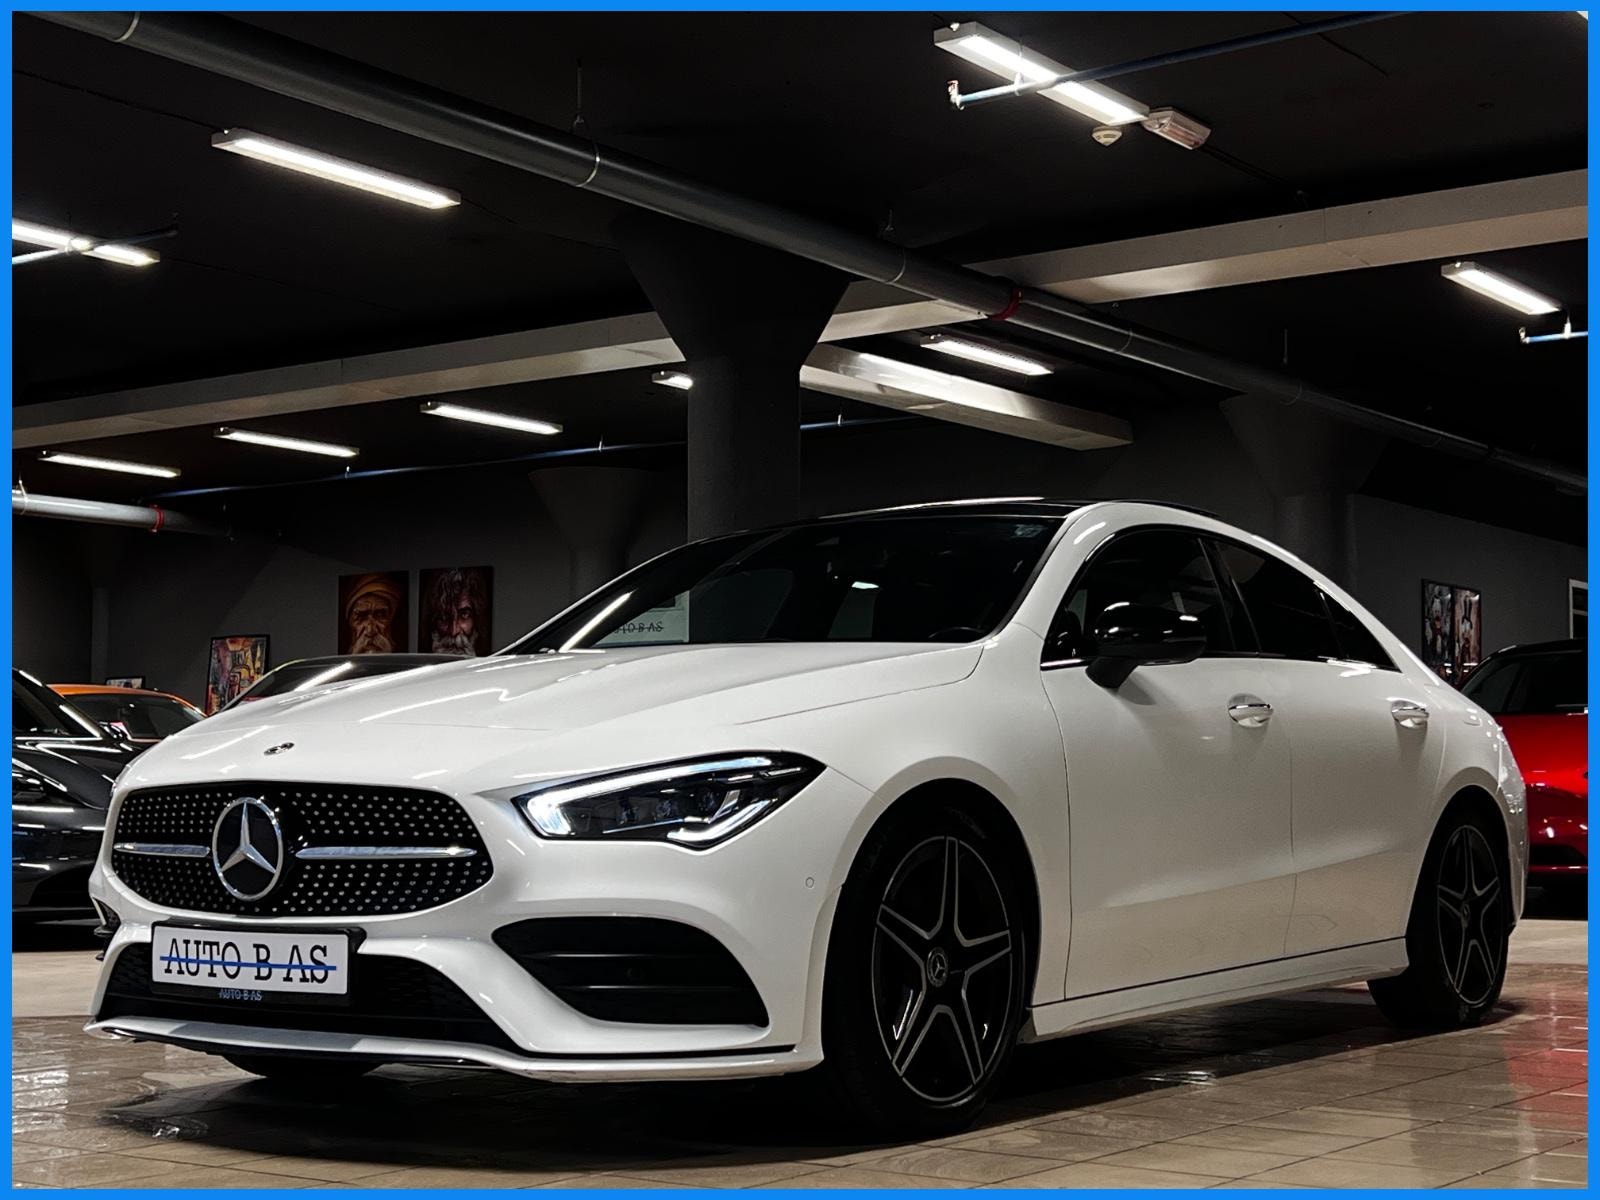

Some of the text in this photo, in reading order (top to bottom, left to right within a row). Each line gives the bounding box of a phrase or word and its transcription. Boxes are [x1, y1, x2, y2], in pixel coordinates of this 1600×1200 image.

[648, 621, 663, 633] AS
[164, 938, 329, 984] AUTO B AS
[219, 988, 262, 1001] AUTO B AS
